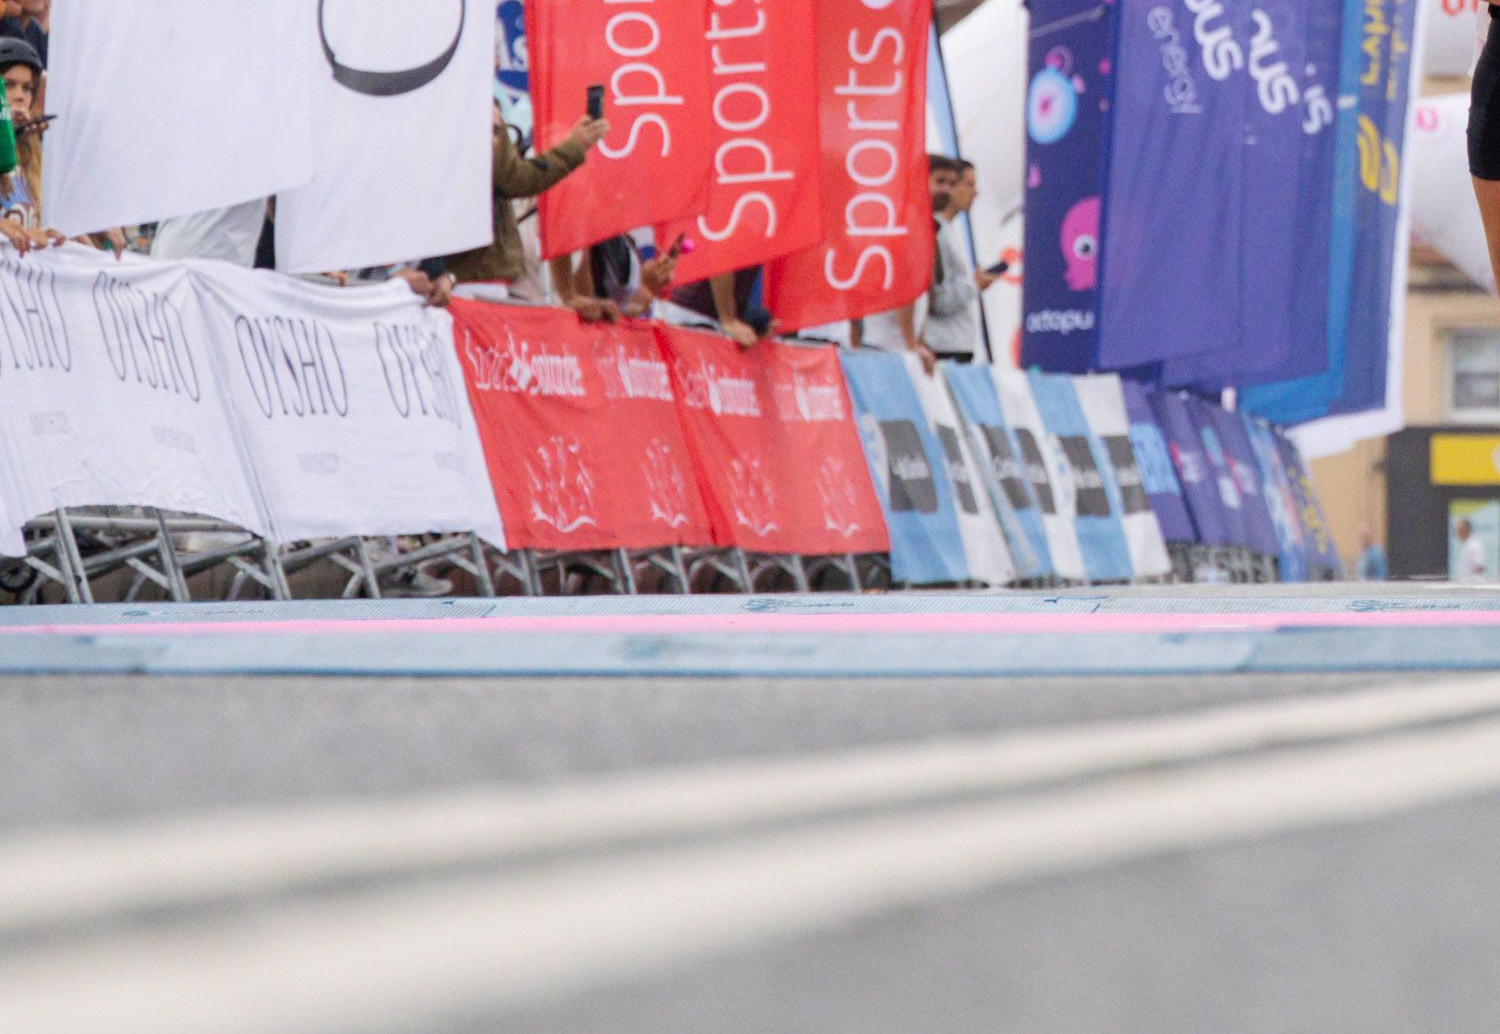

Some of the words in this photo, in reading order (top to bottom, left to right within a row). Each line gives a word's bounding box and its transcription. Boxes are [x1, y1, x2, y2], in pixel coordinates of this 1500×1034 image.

[1147, 6, 1202, 114] energy
[824, 28, 908, 290] Sports
[234, 315, 348, 419] OYSHO
